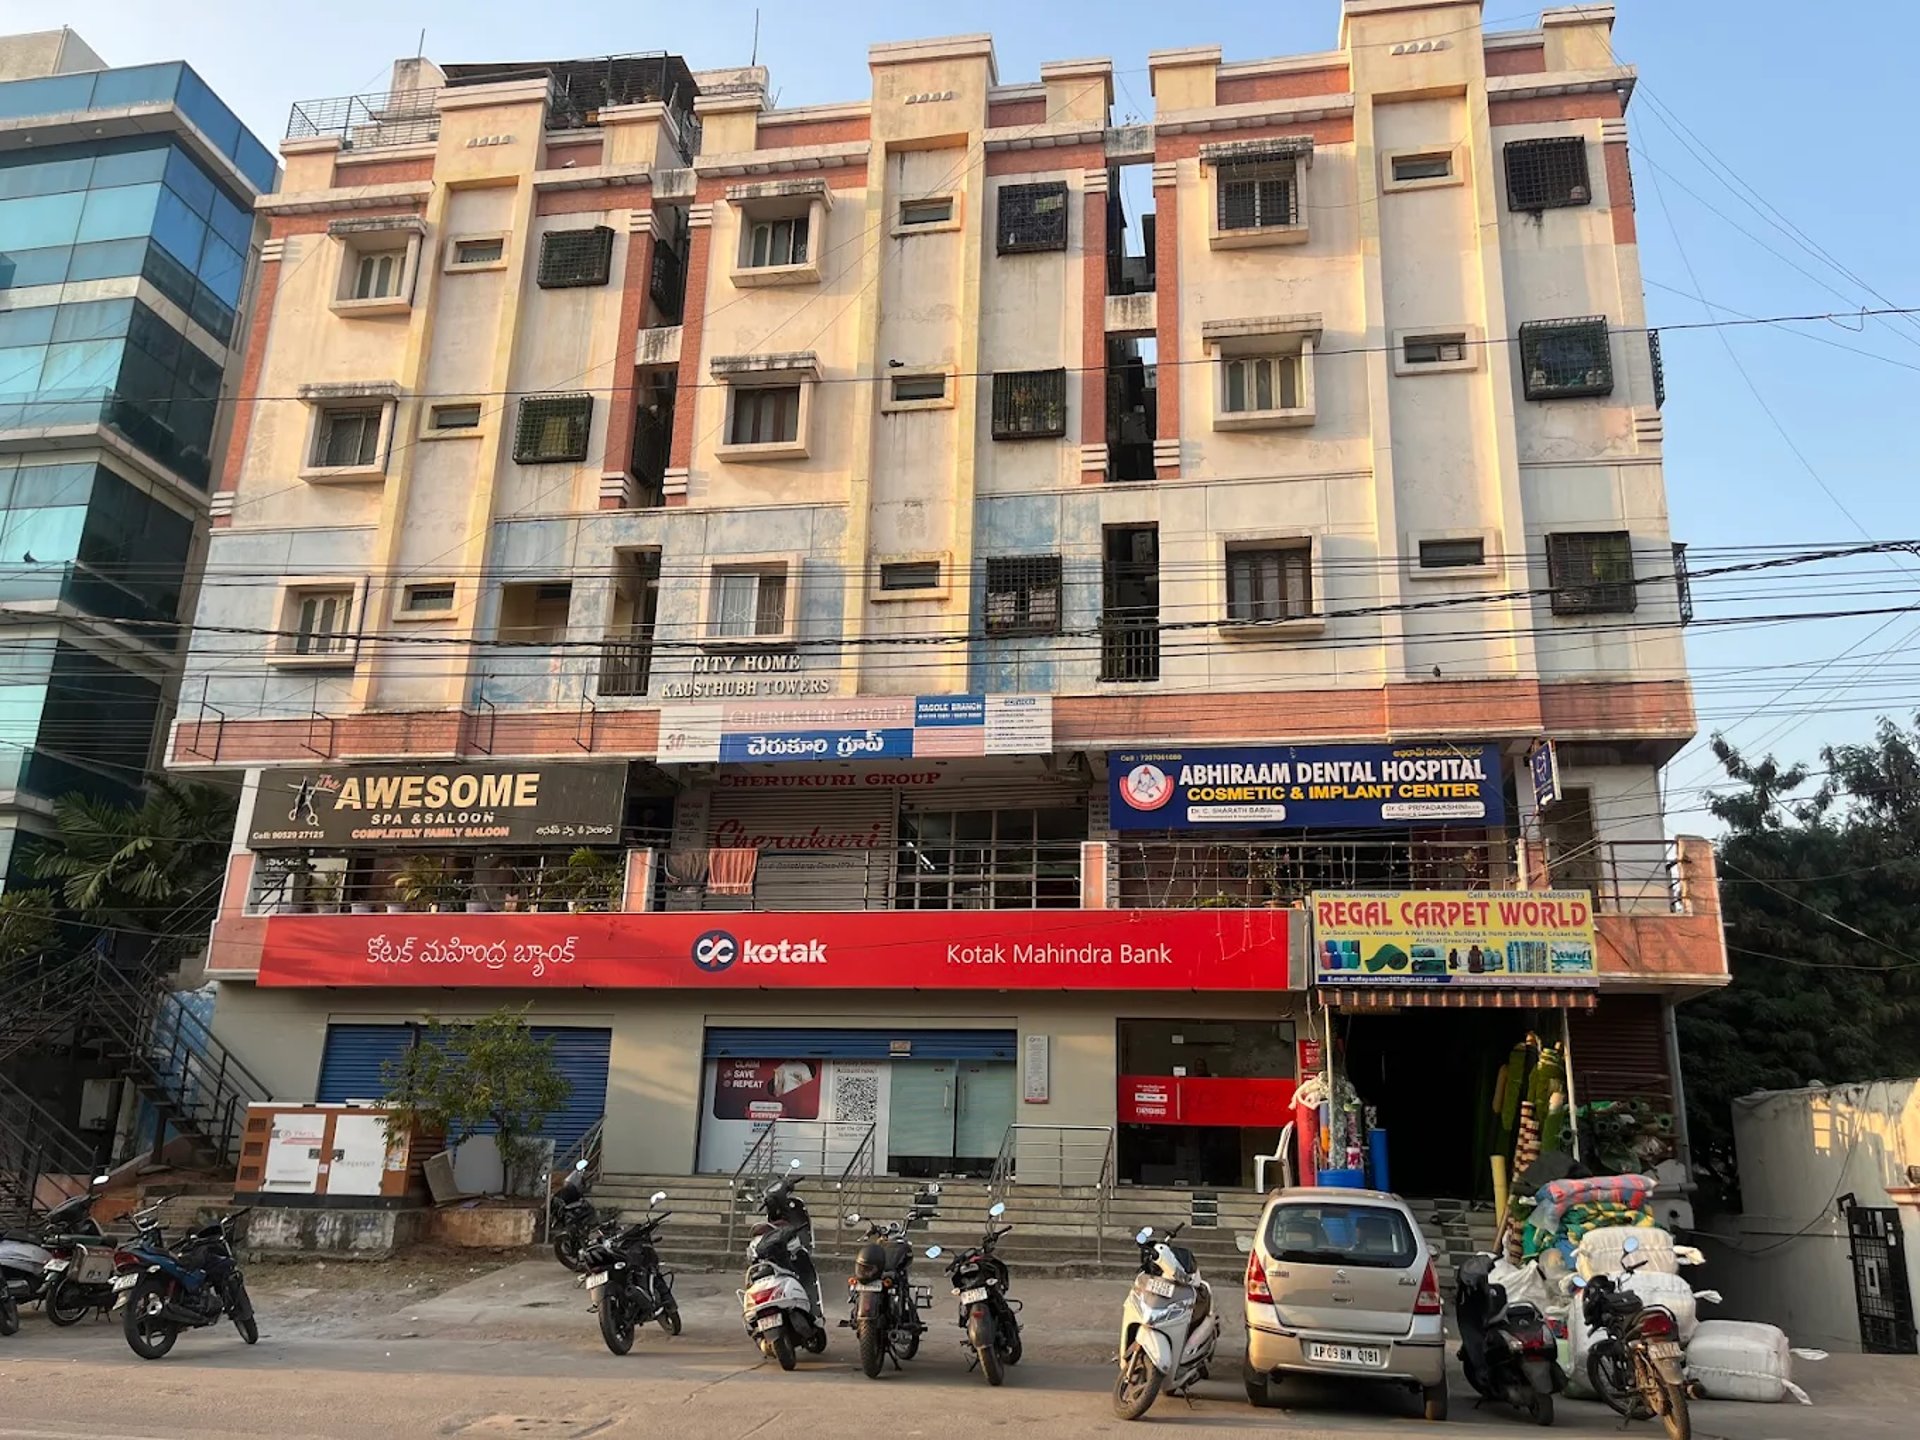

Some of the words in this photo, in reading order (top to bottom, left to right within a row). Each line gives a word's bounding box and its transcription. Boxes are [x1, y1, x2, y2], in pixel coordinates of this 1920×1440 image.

[691, 655, 736, 672] CITY
[744, 654, 800, 671] HOME
[661, 681, 758, 697] KAUSTHUBH
[764, 678, 830, 695] TOWERS
[719, 773, 857, 788] CHERUKURI
[864, 772, 942, 785] GROUP
[1179, 762, 1291, 786] ABHIRAAM
[1297, 761, 1376, 784] DENTAL
[1381, 758, 1487, 783] HOSPITAL
[334, 773, 541, 810] AWESOME
[1187, 786, 1285, 801] COSMETIC
[1290, 785, 1304, 800] &
[1309, 784, 1393, 800] IMPLANT
[1398, 783, 1480, 798] CENTER
[371, 813, 403, 825] SPA
[351, 828, 422, 840] COMPLETELY
[423, 827, 463, 839] FAMILY
[464, 826, 510, 838] SALOON
[712, 819, 881, 850] Cherukuri
[1318, 901, 1393, 928] REGAL
[1400, 901, 1490, 928] CARPET
[1498, 901, 1588, 928] WORLD
[367, 934, 418, 962] కోటక్
[513, 936, 579, 977] బ్యాంక్
[743, 938, 827, 964] kotak
[946, 943, 1006, 964] Kotak
[1013, 943, 1112, 964] Mahindra
[1120, 943, 1172, 964] Bank
[732, 1079, 764, 1088] REPEAT
[733, 1069, 755, 1079] SAVE
